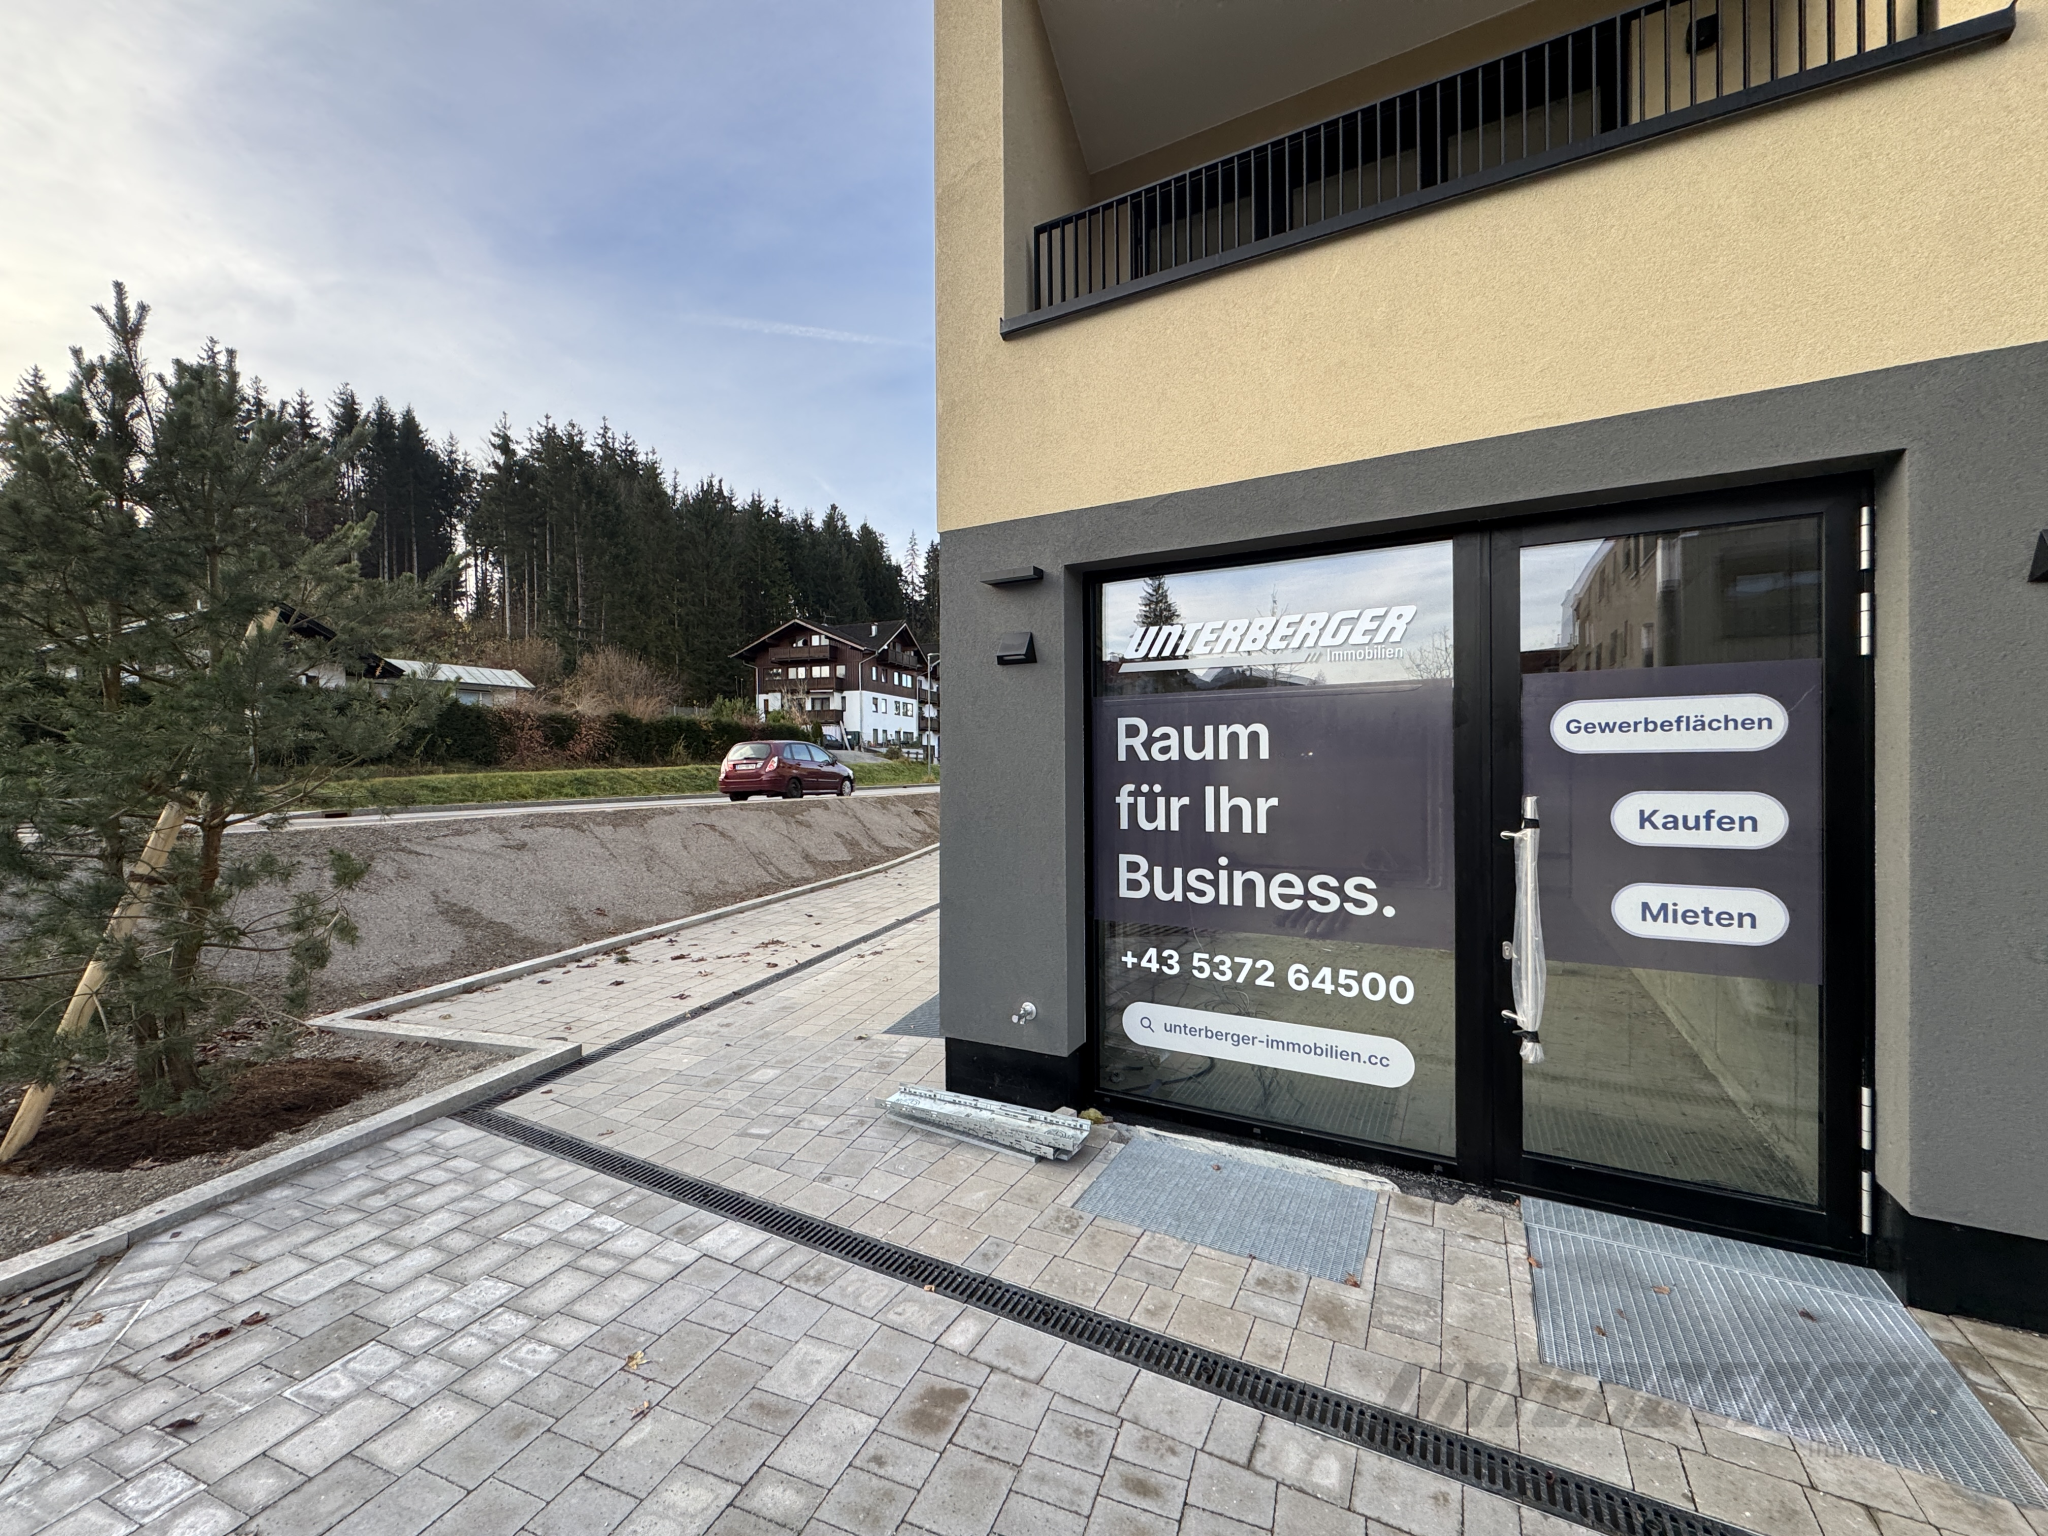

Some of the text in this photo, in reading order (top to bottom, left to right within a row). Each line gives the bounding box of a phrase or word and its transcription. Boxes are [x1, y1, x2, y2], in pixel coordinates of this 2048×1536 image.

[1124, 605, 1417, 660] UNTERBERGER
[1327, 645, 1404, 662] Immobilien
[1117, 717, 1270, 761] Raum
[1565, 714, 1773, 735] Gewerbeflächen
[1115, 784, 1279, 834] für Ihr
[1638, 809, 1759, 832] Kaufen
[1118, 853, 1396, 918] Business.
[1640, 901, 1758, 929] Mieten
[1121, 947, 1415, 1005] +43 5372 64500
[1163, 1020, 1391, 1068] unterberger-immobilien.cc
